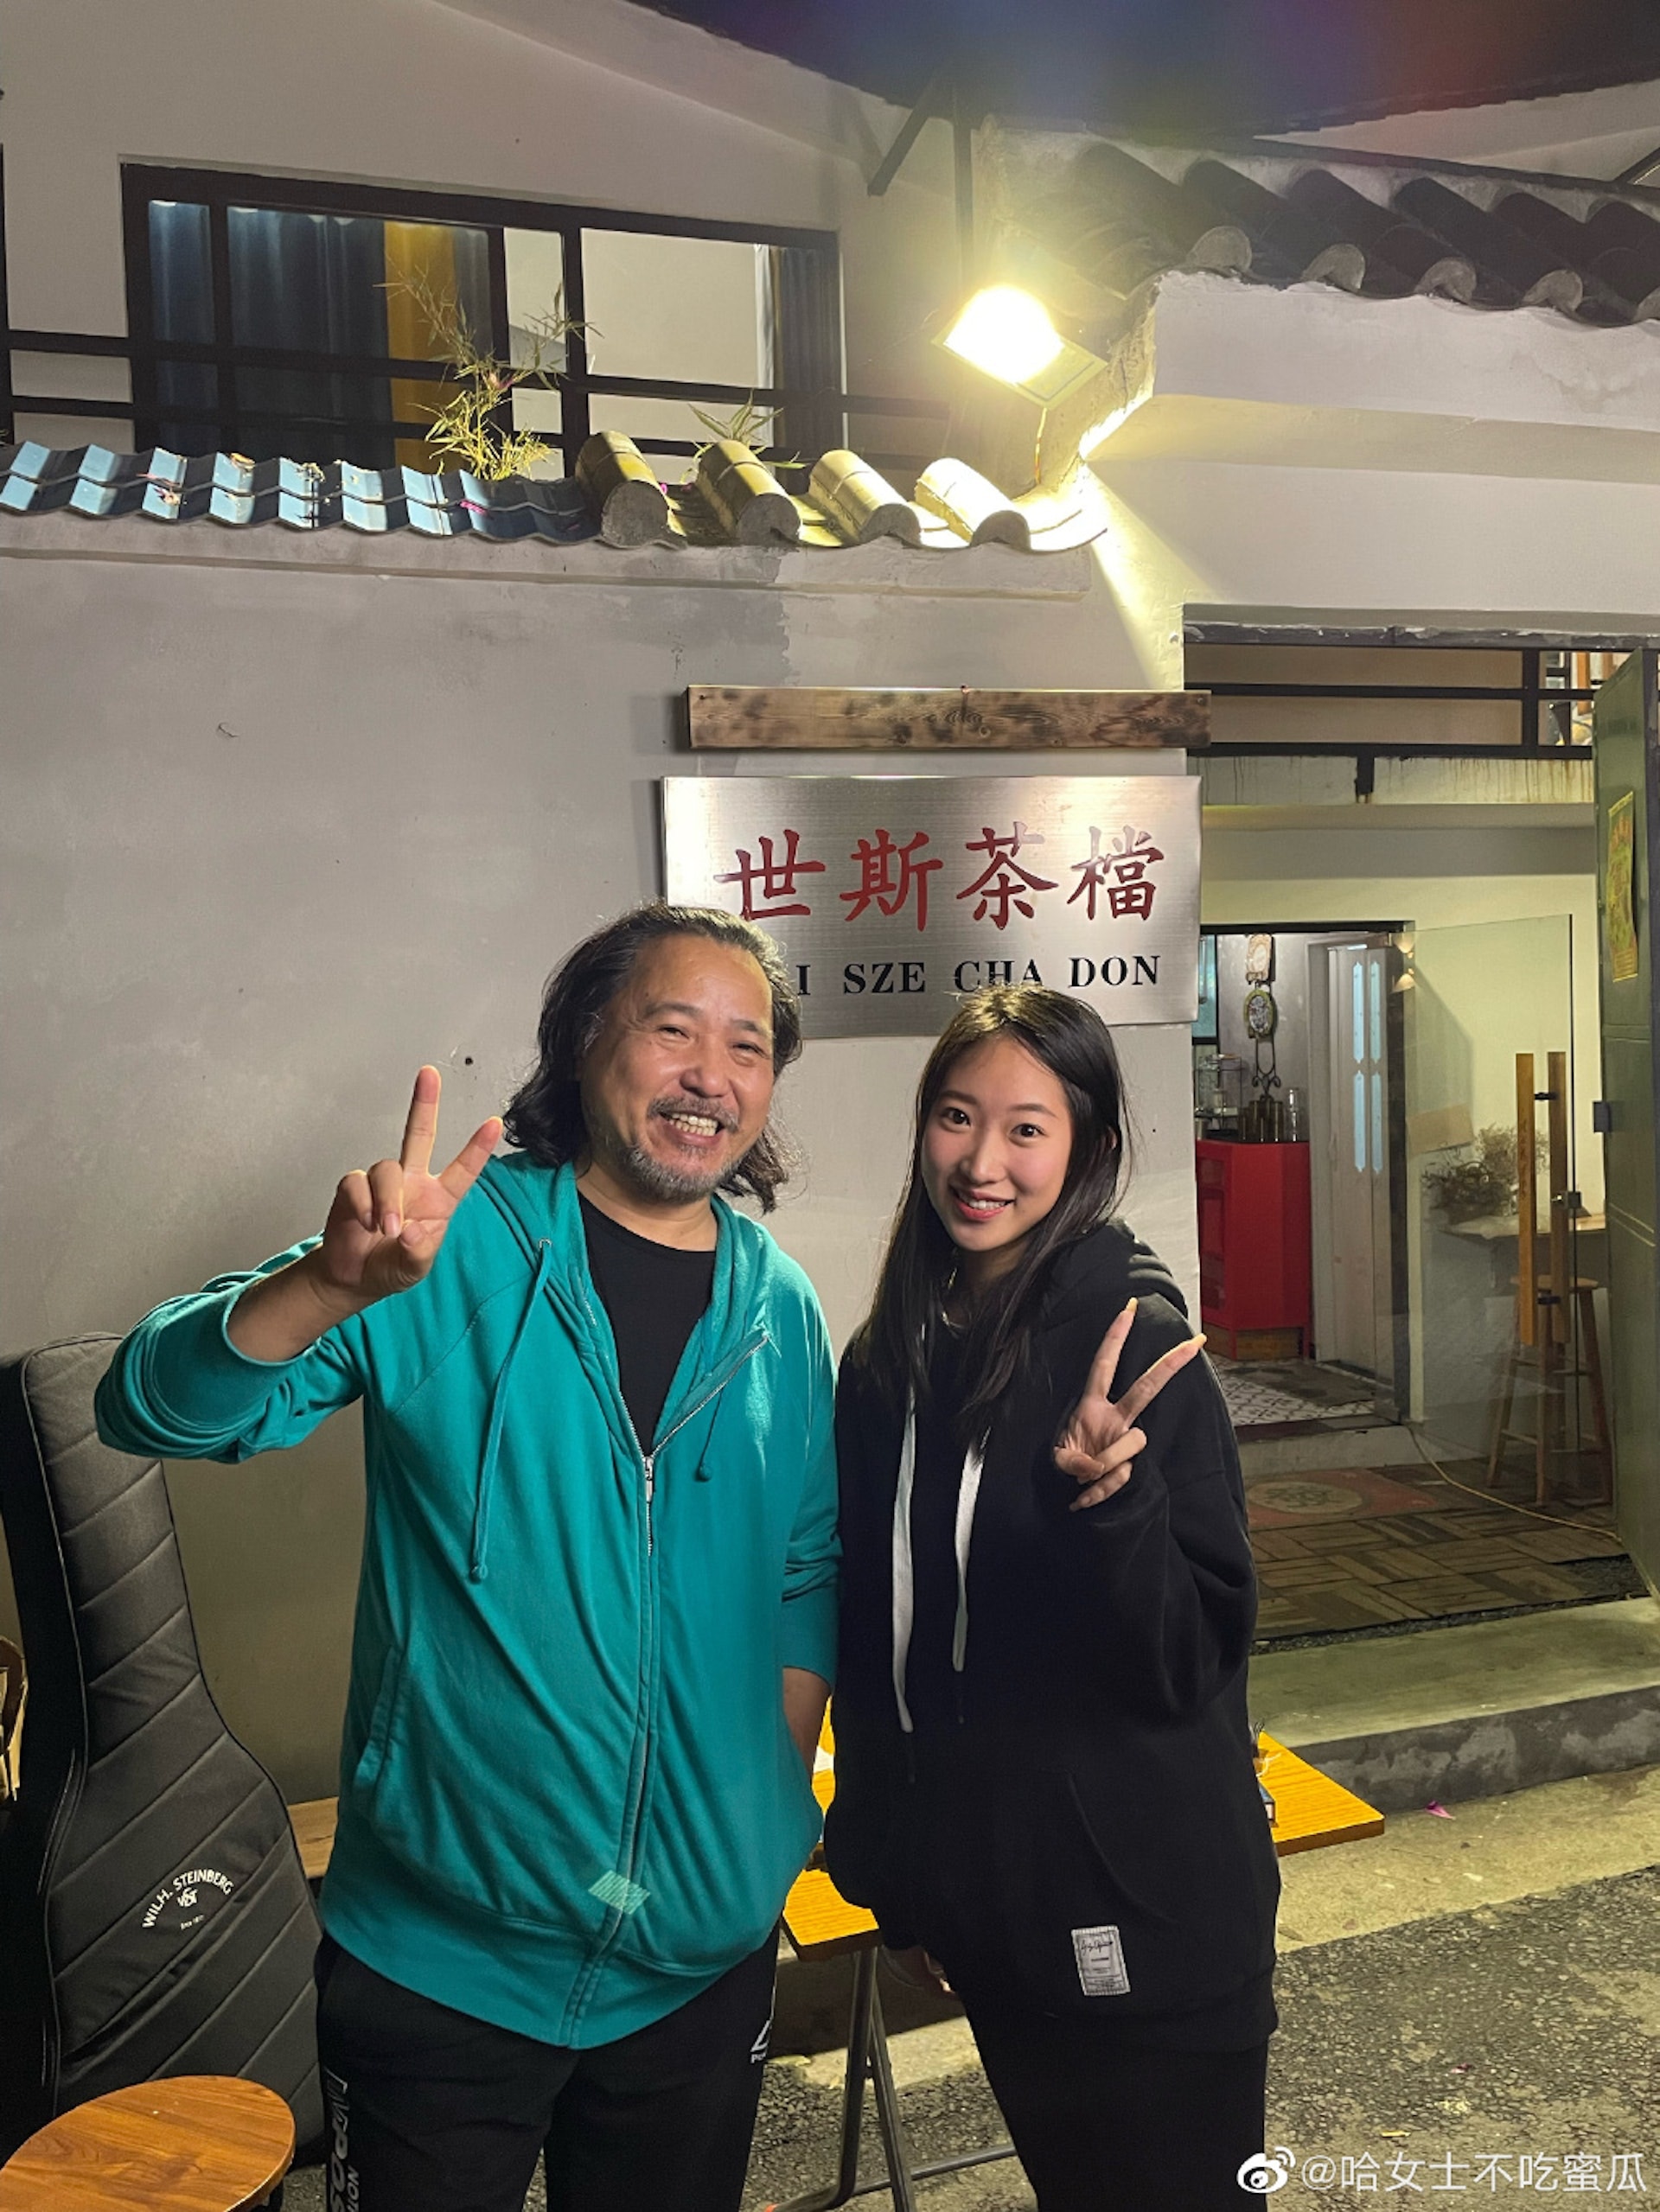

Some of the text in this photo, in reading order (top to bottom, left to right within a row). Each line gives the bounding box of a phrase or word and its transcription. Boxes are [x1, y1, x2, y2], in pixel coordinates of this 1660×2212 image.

[713, 821, 1164, 932] 世斯茶檔
[844, 961, 926, 994] SZE
[954, 959, 1043, 992] CHA
[1069, 955, 1160, 988] DON
[142, 1889, 173, 1928] WILH.
[173, 1869, 234, 1895] STEINBERG
